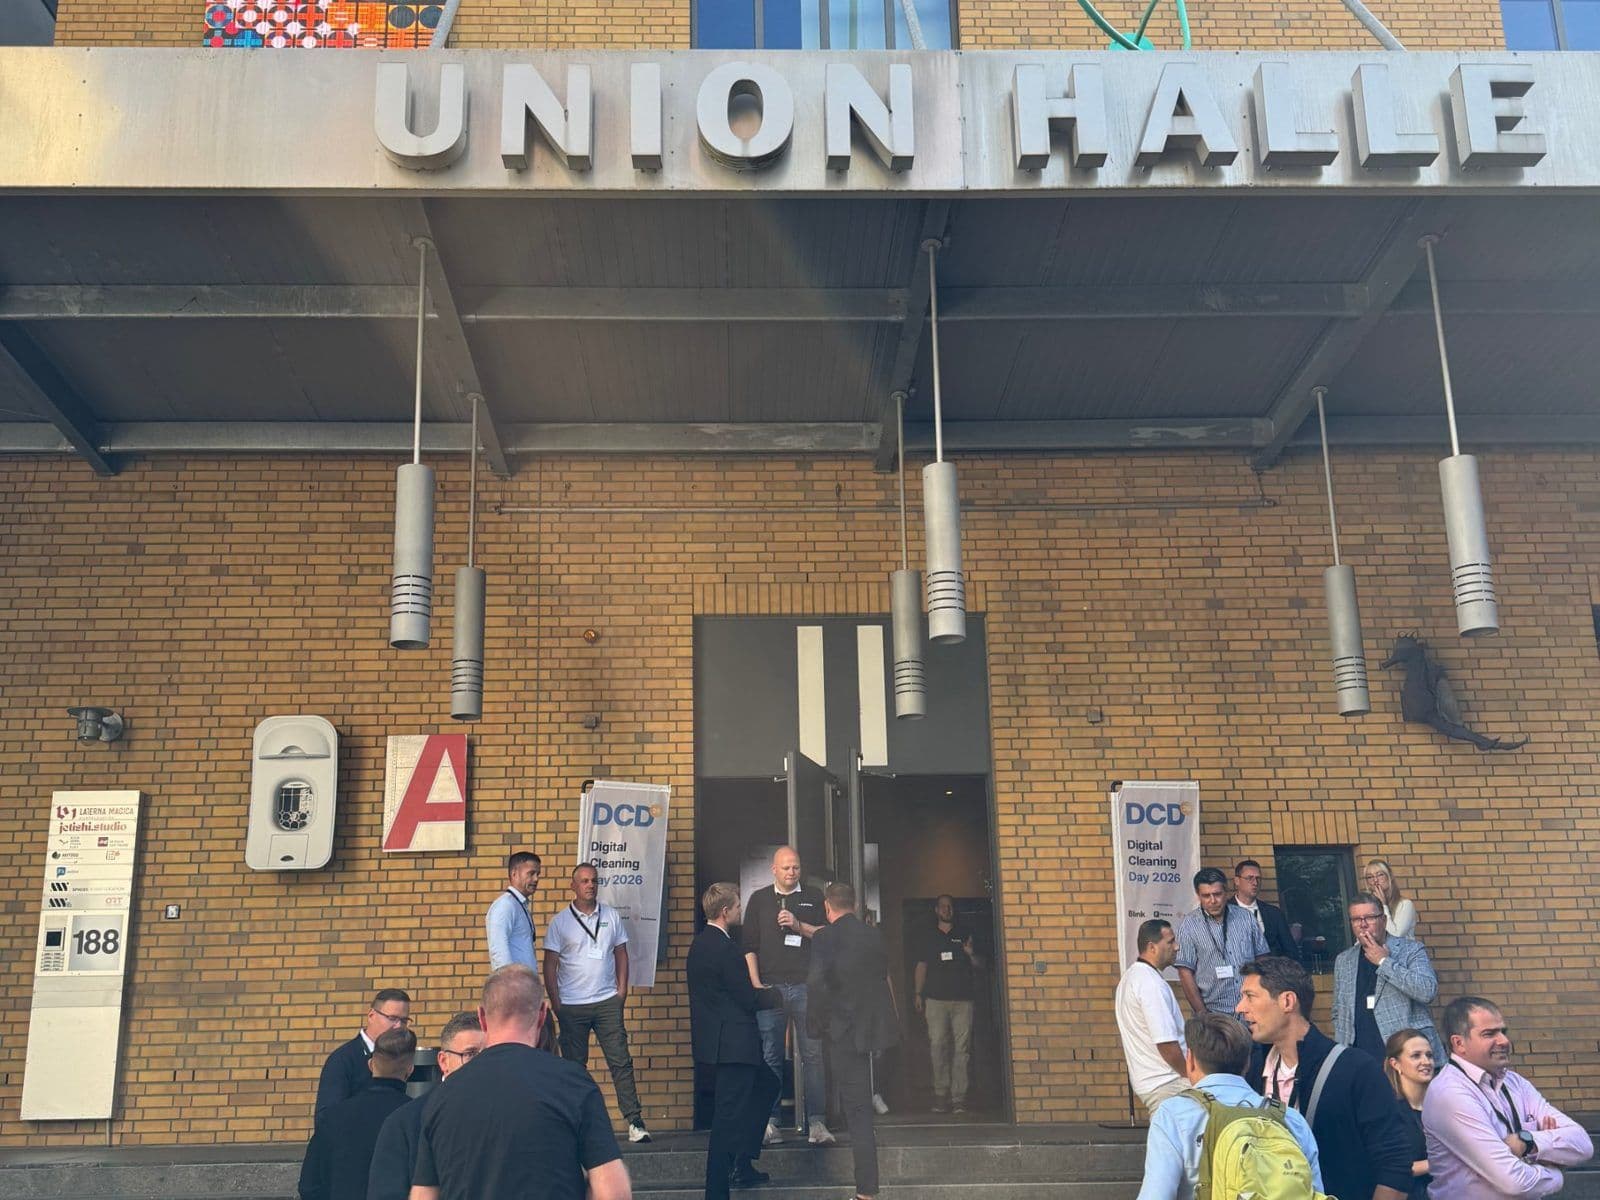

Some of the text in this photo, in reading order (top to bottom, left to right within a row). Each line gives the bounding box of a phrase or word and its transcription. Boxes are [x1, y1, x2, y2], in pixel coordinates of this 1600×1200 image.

[374, 61, 1548, 171] UNION HALLE
[593, 803, 654, 827] DCD
[1126, 803, 1185, 825] DCD
[591, 842, 627, 854] Digital
[1127, 840, 1163, 852] Digital
[590, 858, 640, 871] Cleaning
[1128, 856, 1177, 869] Cleaning
[612, 875, 643, 885] 2026
[1128, 872, 1181, 884] Day 2026
[73, 929, 119, 954] 188
